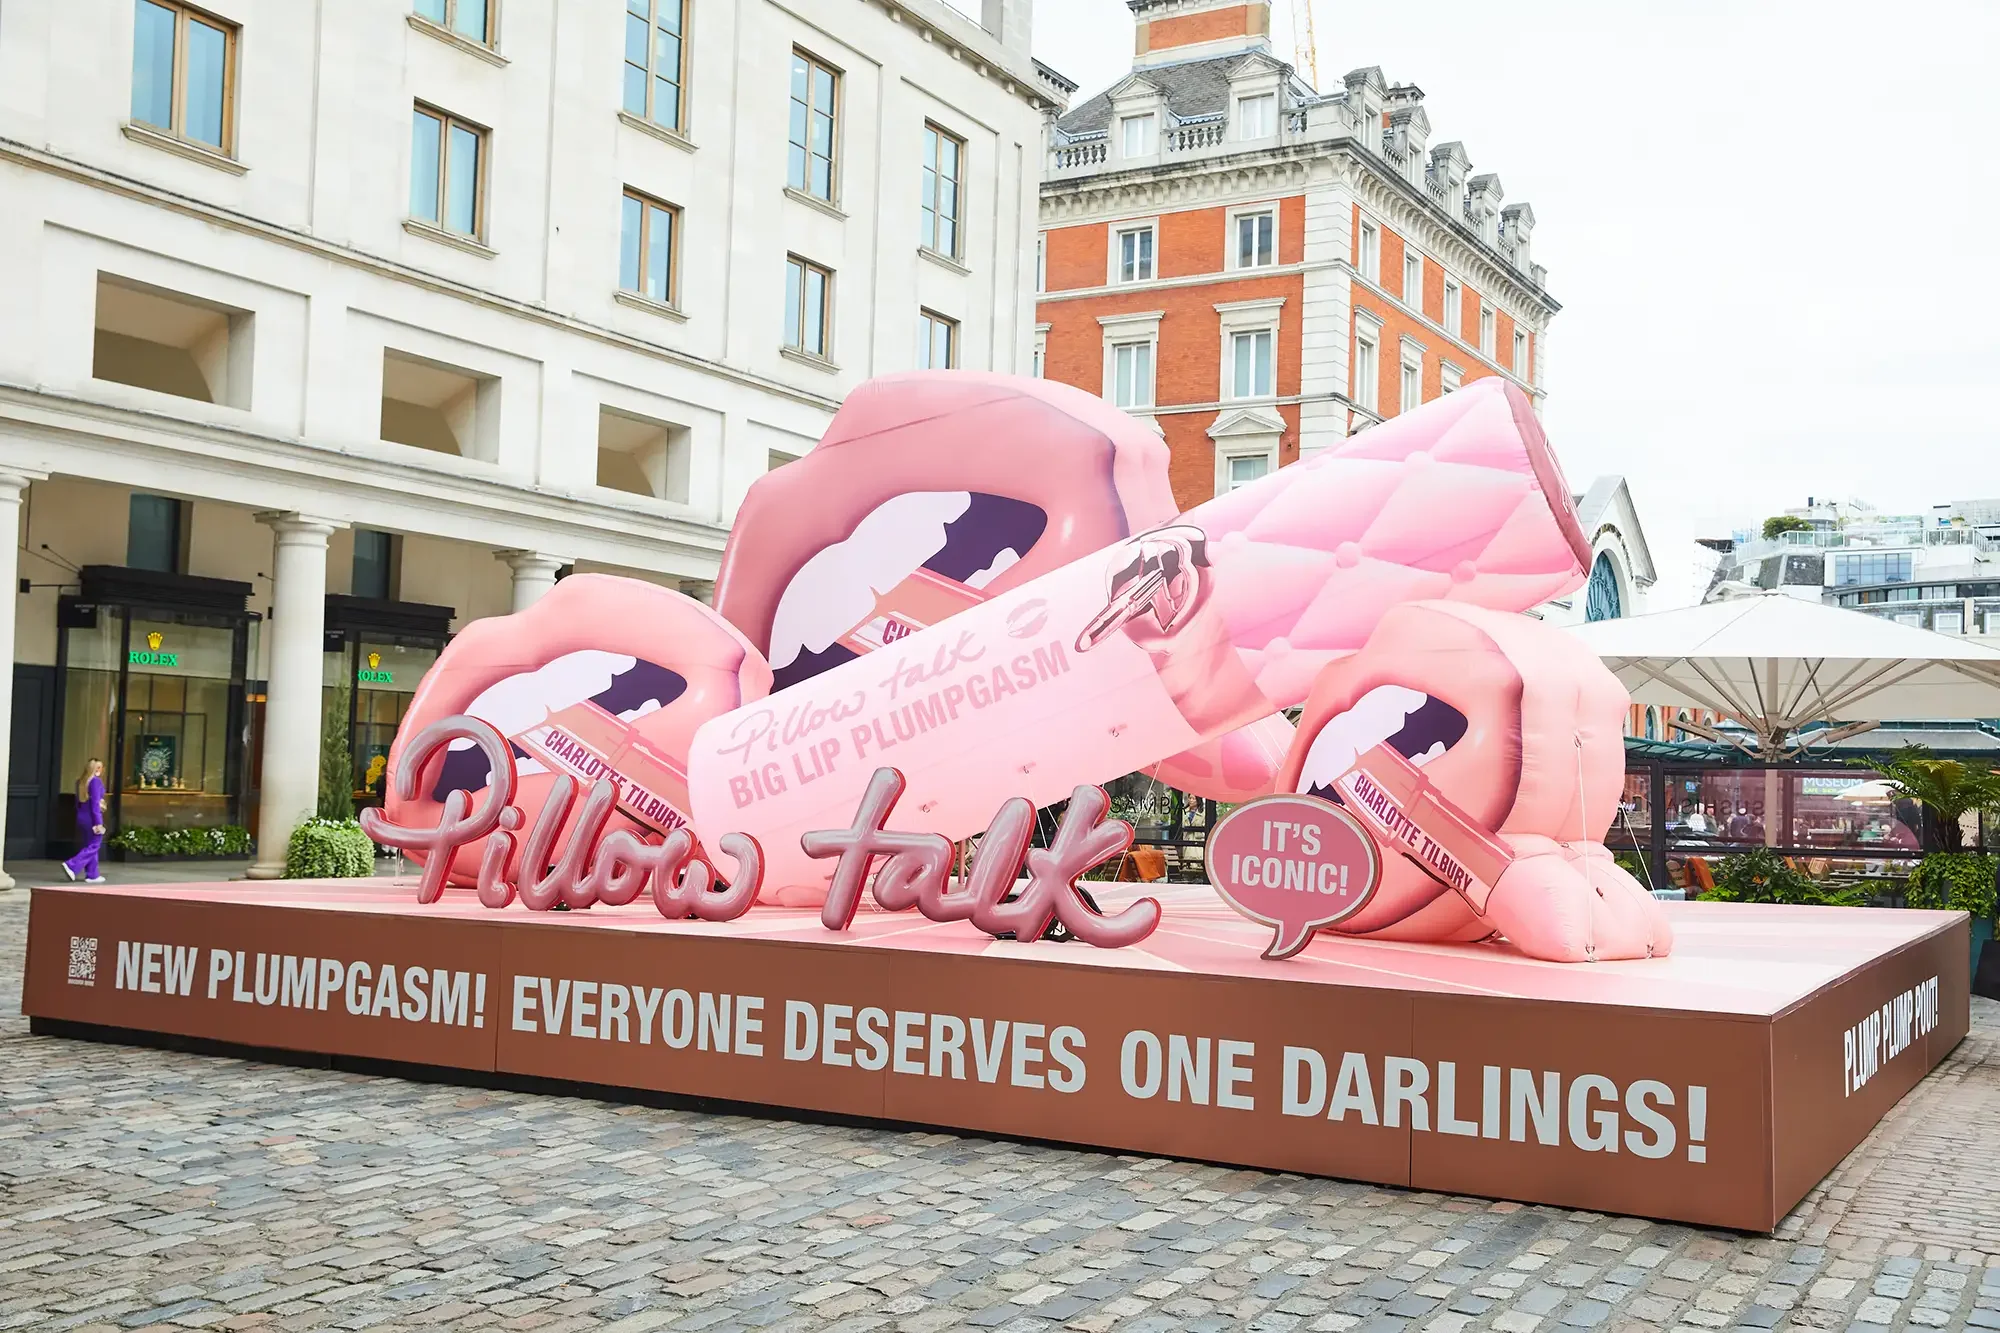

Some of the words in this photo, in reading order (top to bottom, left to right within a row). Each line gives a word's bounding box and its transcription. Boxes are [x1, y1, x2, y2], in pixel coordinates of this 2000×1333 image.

[128, 651, 178, 667] ROLEX
[716, 691, 866, 765] Pillow
[728, 761, 788, 809] BIG
[792, 737, 841, 785] LIP
[850, 640, 1070, 759] PLUMPGASM
[1110, 796, 1188, 815] SAMBA
[1803, 777, 1864, 788] MUSEUM
[360, 714, 766, 922] Pillow
[800, 766, 1162, 949] talk
[1262, 820, 1322, 856] IT'S
[1354, 775, 1421, 848] CHARLOTTE
[1420, 836, 1473, 893] TILBURY
[1231, 854, 1349, 896] ICONIC!
[115, 940, 198, 996] NEW
[207, 949, 487, 1029] PLUMPGASM!
[511, 975, 765, 1057] EVERYONE
[783, 999, 1087, 1094] DESERVES
[1120, 1030, 1255, 1111] ONE
[1281, 1045, 1707, 1164] DARLINGS!
[1844, 1009, 1880, 1098] PLUMP
[1882, 989, 1914, 1065] PLUMP
[1915, 975, 1938, 1040] POUT!
